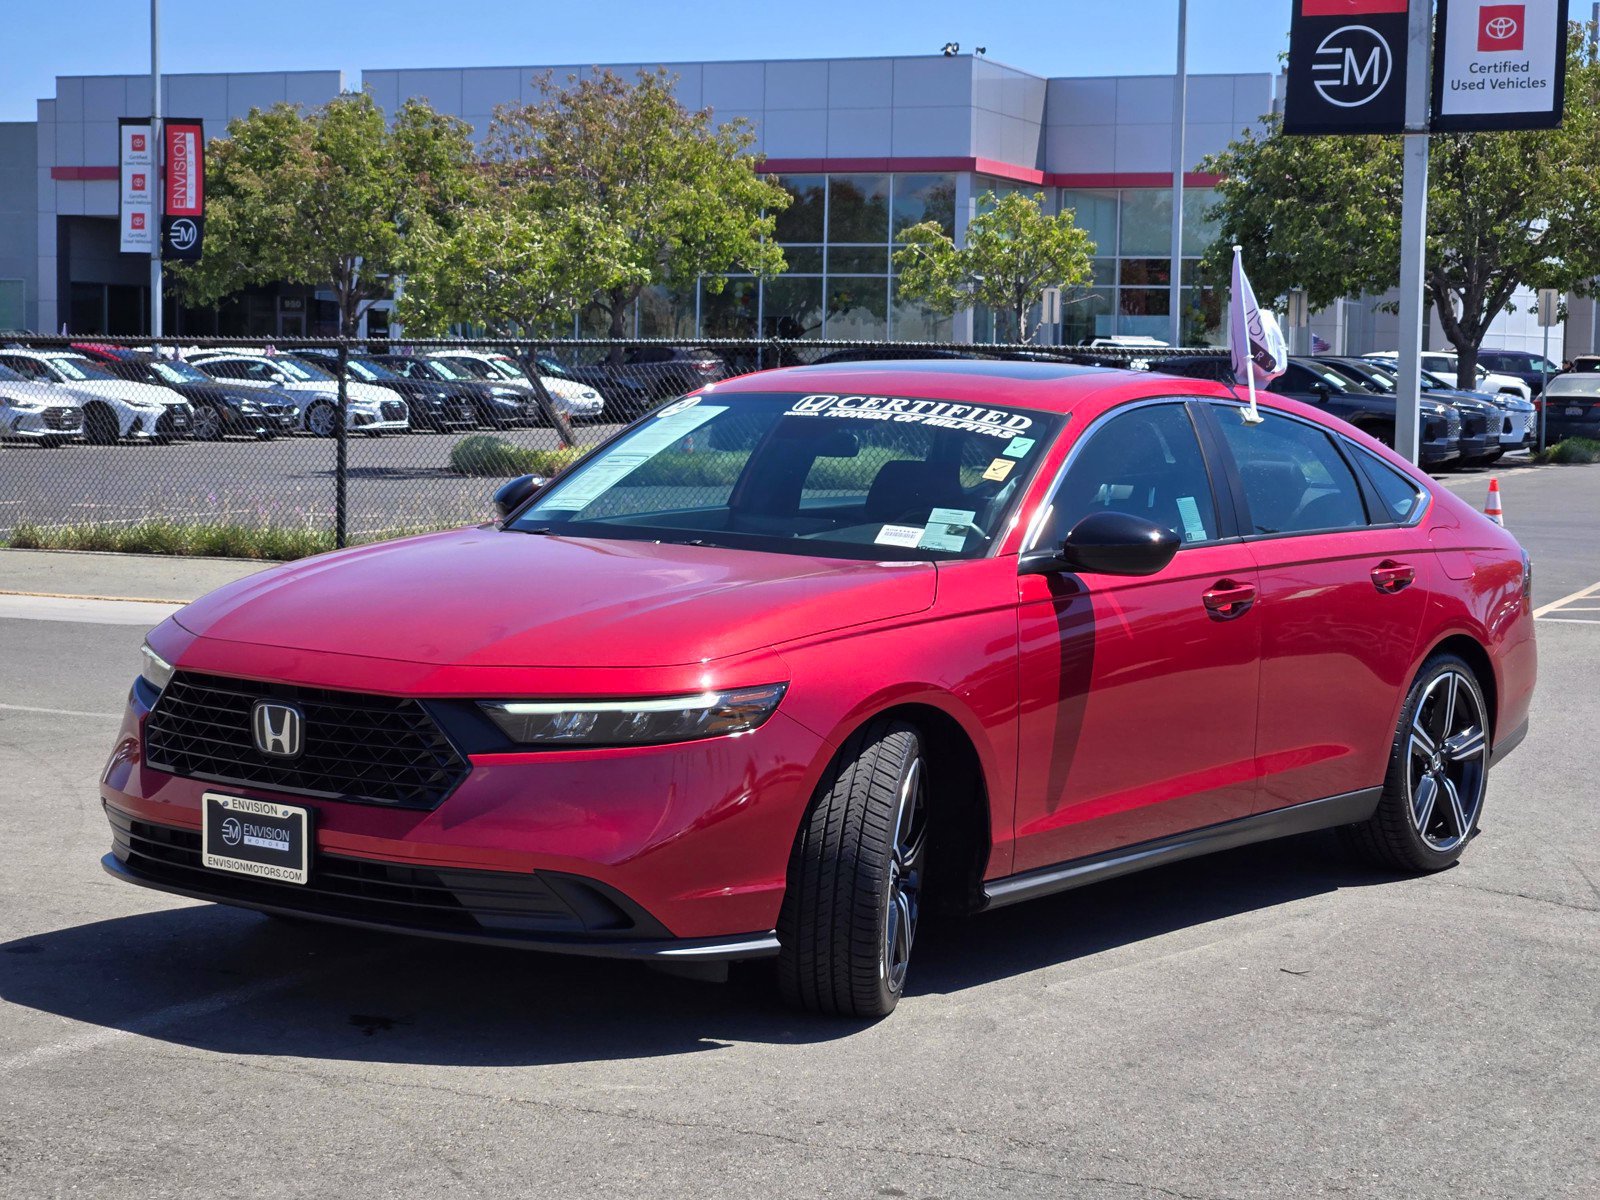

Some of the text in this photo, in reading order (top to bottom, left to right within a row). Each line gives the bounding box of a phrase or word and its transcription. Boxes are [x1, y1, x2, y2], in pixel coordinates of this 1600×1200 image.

[1469, 60, 1529, 74] Certified
[1451, 77, 1547, 91] Used Vehicles
[173, 132, 187, 209] ENVISION
[836, 396, 1033, 430] CERTIFIED
[823, 410, 1017, 439] HONDA OF MILPITAS
[232, 799, 278, 816] ENVISION
[243, 823, 290, 842] ENVISION
[247, 837, 287, 849] MOTORS
[207, 856, 302, 881] ENVISIONMOTORS.COM
